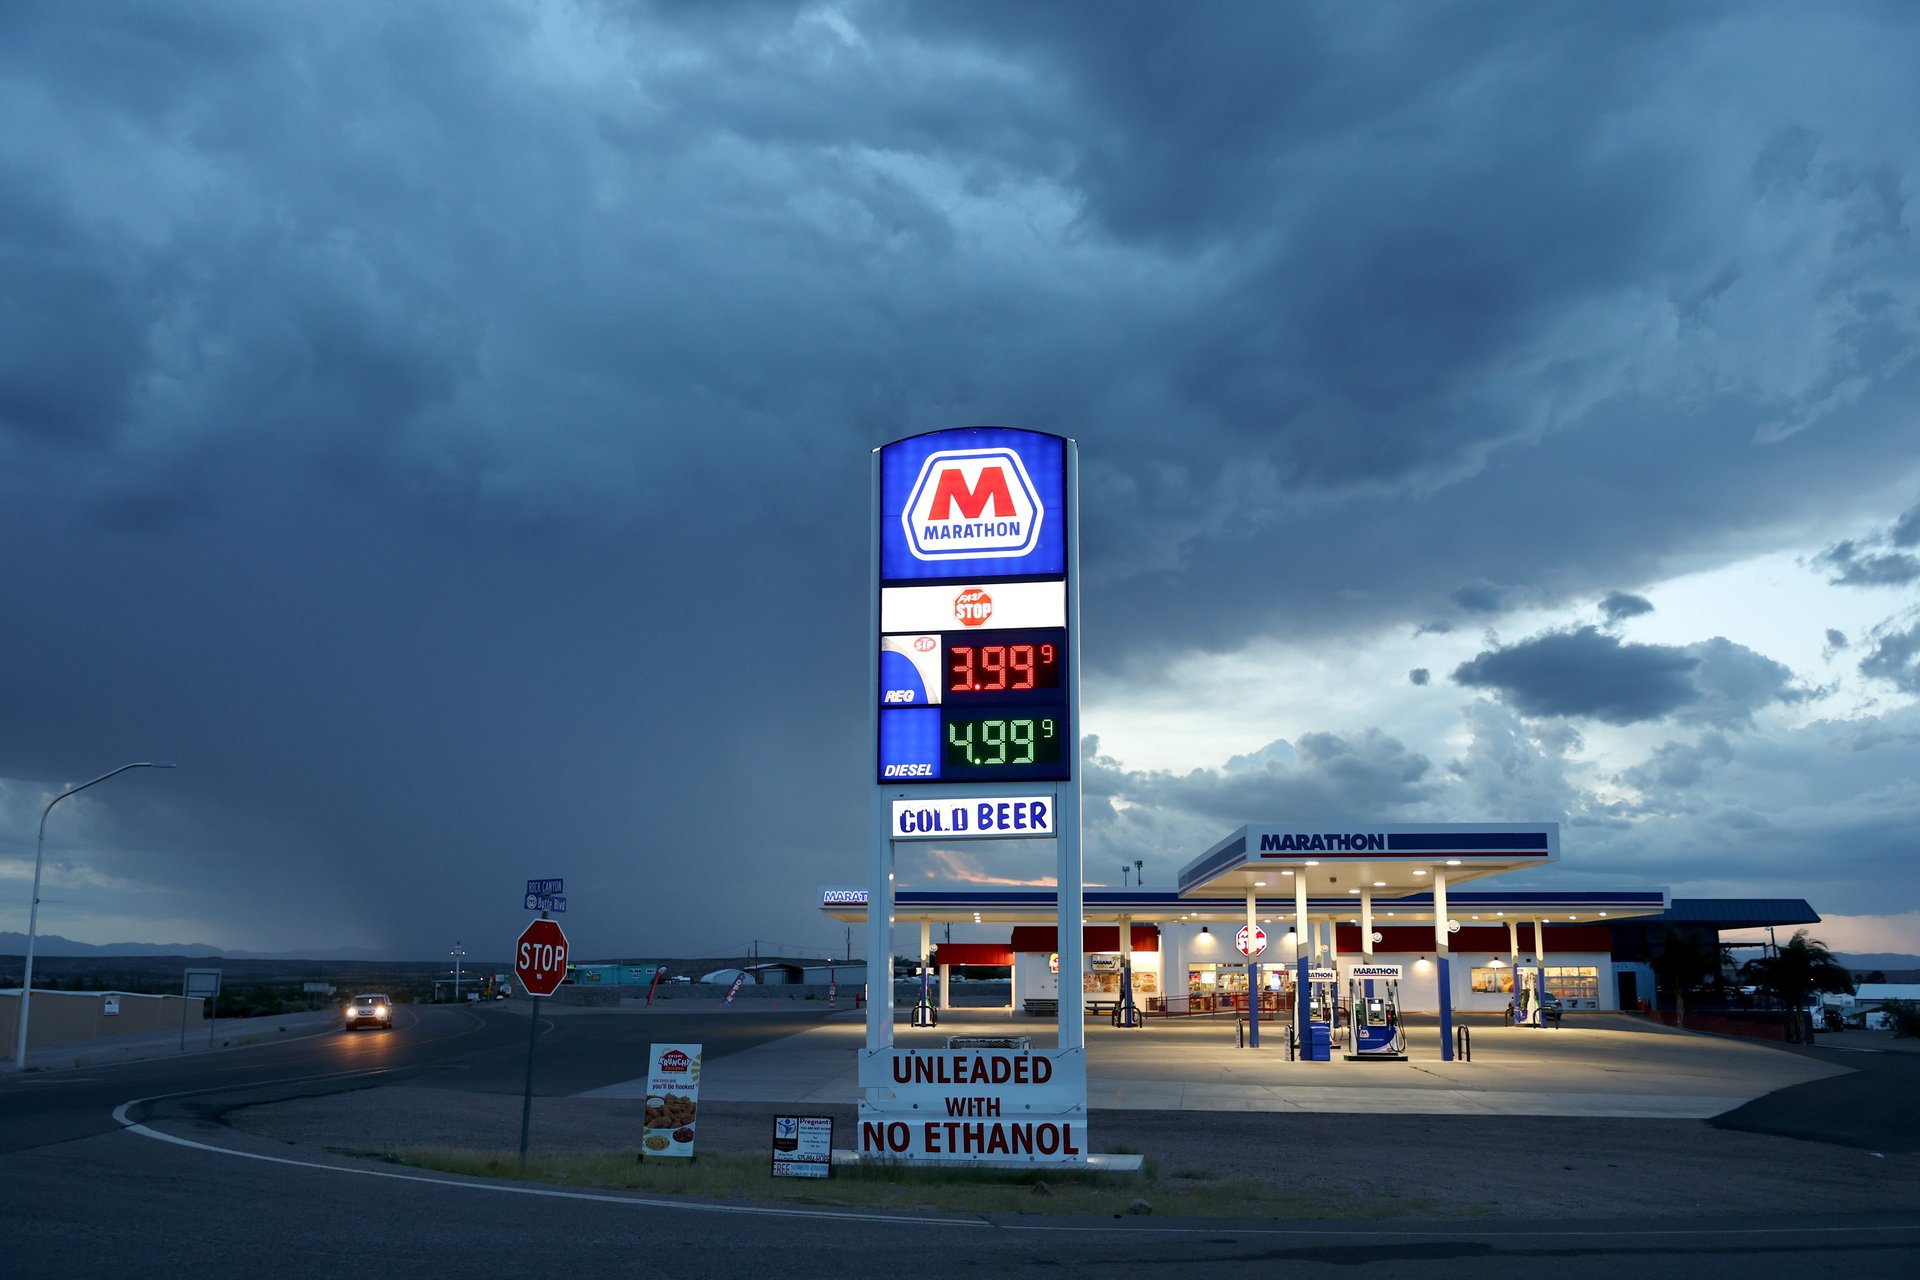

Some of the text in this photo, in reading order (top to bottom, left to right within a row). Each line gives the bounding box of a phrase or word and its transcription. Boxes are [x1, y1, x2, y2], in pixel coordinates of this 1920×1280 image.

[928, 466, 1017, 520] M
[923, 521, 1021, 540] MARATHON
[956, 602, 991, 619] STOP
[916, 637, 935, 651] STP
[884, 689, 915, 703] REG
[884, 763, 933, 777] DIESEL
[899, 801, 1048, 834] COLD BEER
[1260, 833, 1385, 851] MARATHON
[528, 879, 562, 893] ROCK CANYON
[554, 898, 566, 911] Blvd
[519, 942, 565, 972] STOP
[1353, 967, 1398, 975] MARATHON
[658, 1056, 692, 1067] KRUNCHY
[893, 1055, 1053, 1084] UNLEADED
[945, 1097, 1001, 1117] WITH
[863, 1121, 1079, 1155] NO ETHANOL
